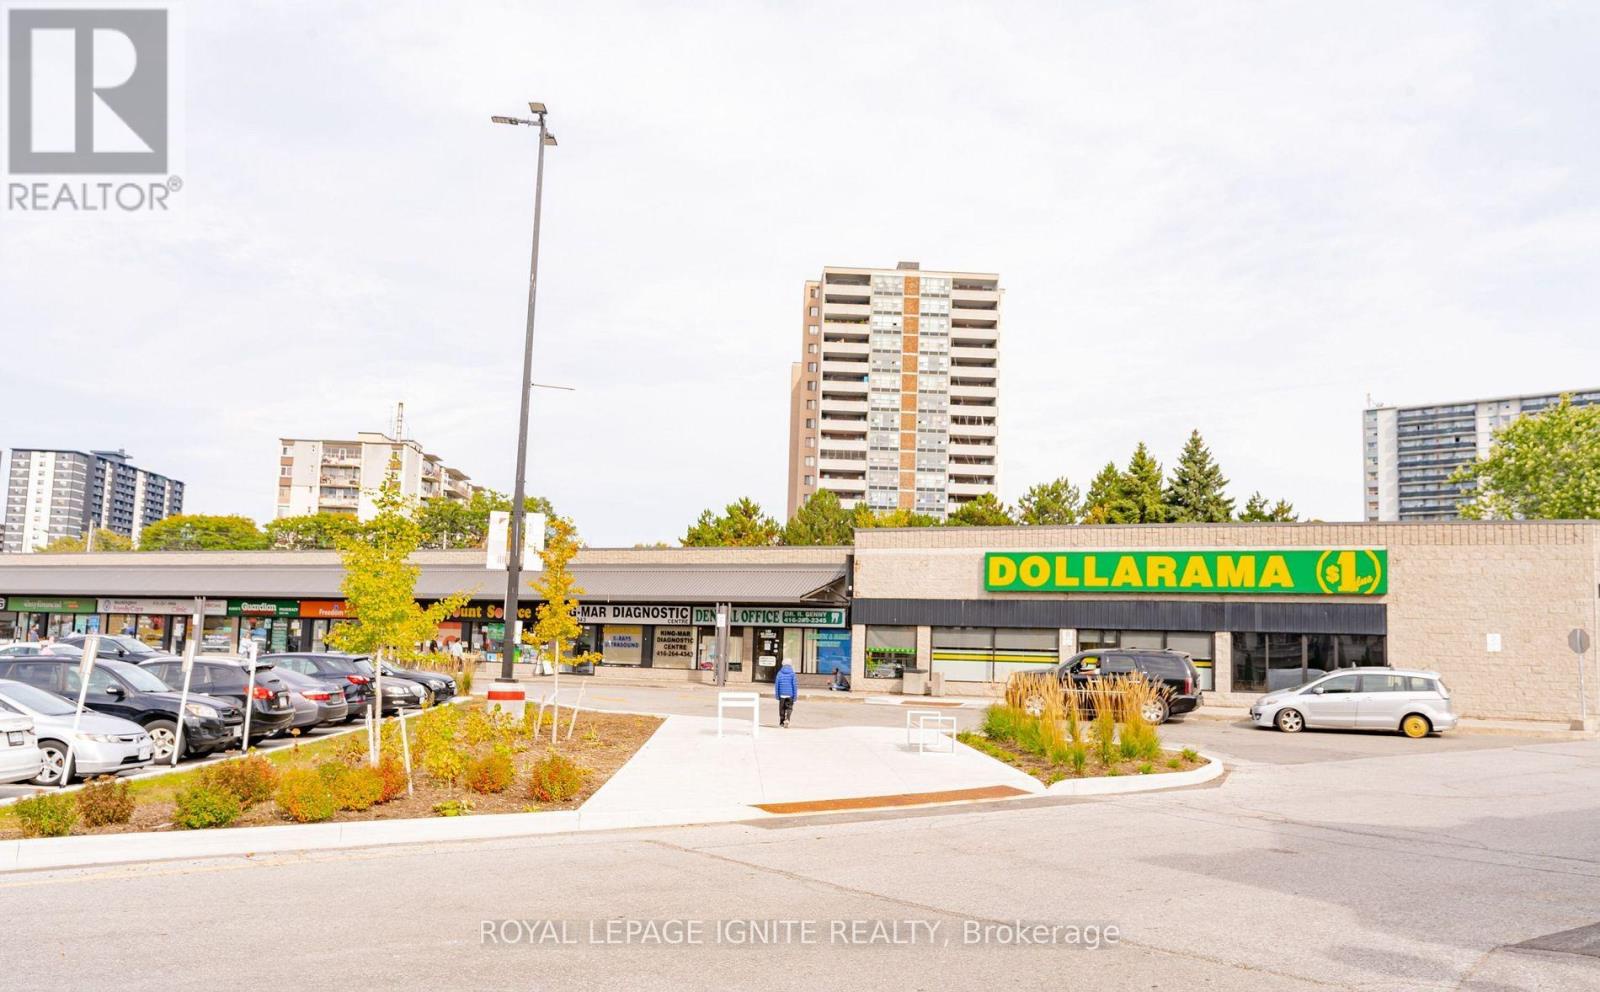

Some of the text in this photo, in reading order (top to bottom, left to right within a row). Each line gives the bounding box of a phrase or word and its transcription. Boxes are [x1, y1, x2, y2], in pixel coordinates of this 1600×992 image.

[988, 555, 1294, 589] DOLLARAMA
[241, 602, 277, 611] Guardian
[319, 608, 344, 616] Freedom
[613, 606, 689, 619] DIAGNOSTIC
[741, 610, 780, 623] OFFICE
[656, 636, 694, 644] DIAGNOSTIC
